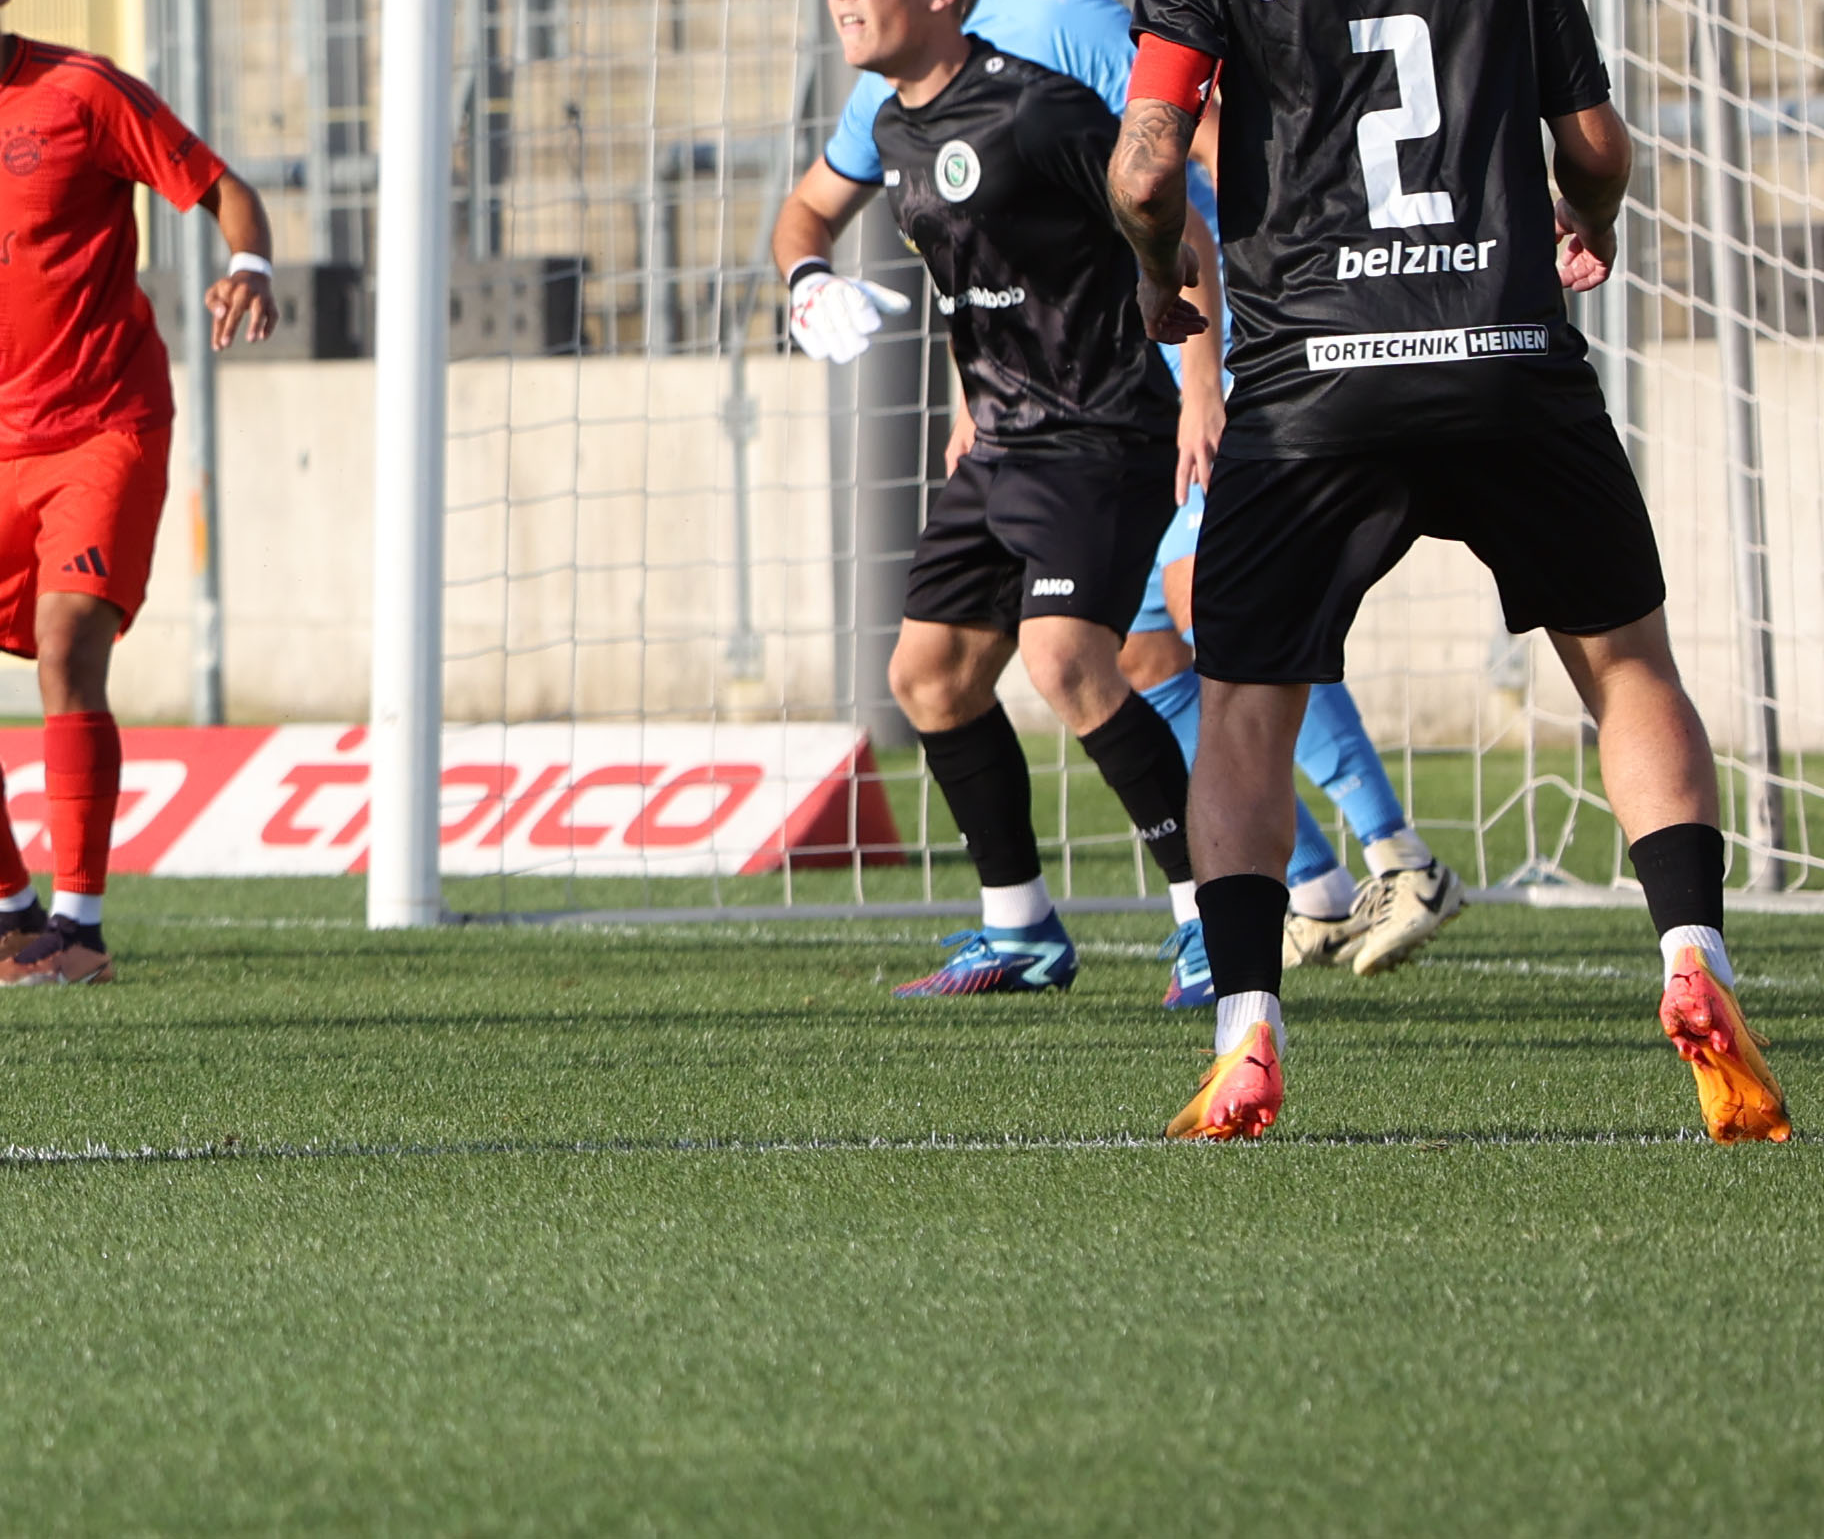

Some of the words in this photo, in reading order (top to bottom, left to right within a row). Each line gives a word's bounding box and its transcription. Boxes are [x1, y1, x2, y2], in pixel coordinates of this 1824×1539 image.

[1348, 13, 1455, 231] 2
[1337, 238, 1497, 280] belzner
[1312, 333, 1461, 365] TORTECHNIK
[1466, 328, 1547, 354] HEINEN
[1031, 577, 1076, 598] JAKO
